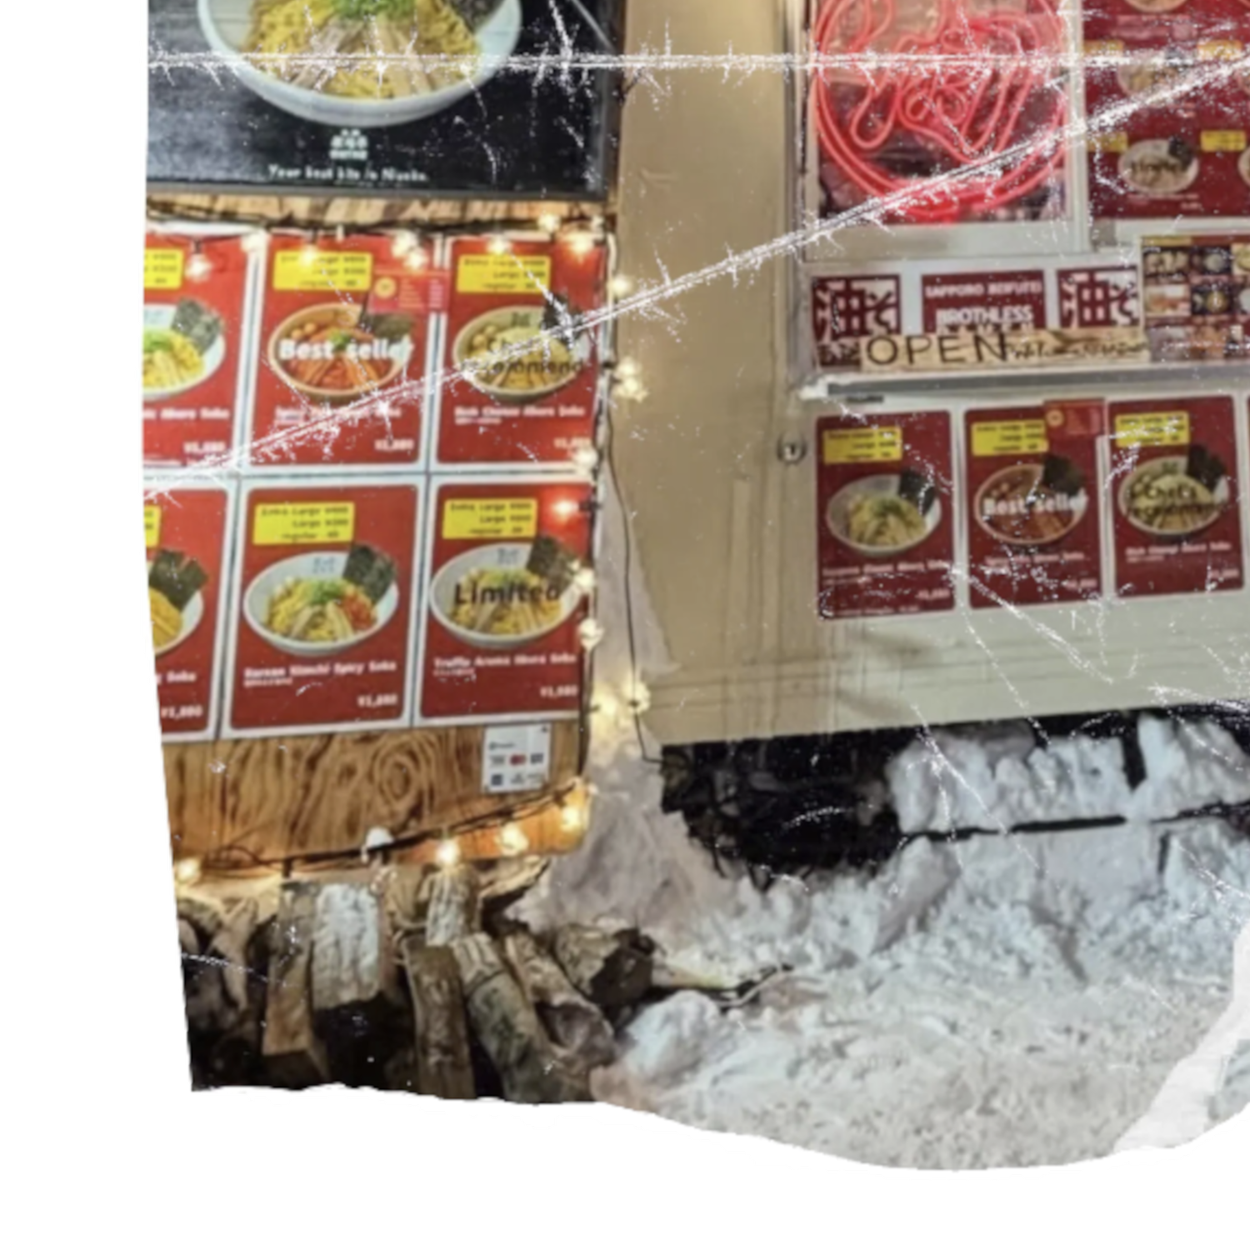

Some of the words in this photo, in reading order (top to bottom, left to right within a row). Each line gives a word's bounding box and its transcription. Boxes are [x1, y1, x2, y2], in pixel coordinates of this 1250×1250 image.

[268, 164, 301, 181] Your
[925, 282, 984, 299] SAPPORO
[935, 305, 1034, 325] BROTHLESS
[279, 337, 335, 361] Best
[866, 332, 1009, 367] OPEN
[983, 497, 1030, 516] Best
[454, 581, 562, 606] Limited
